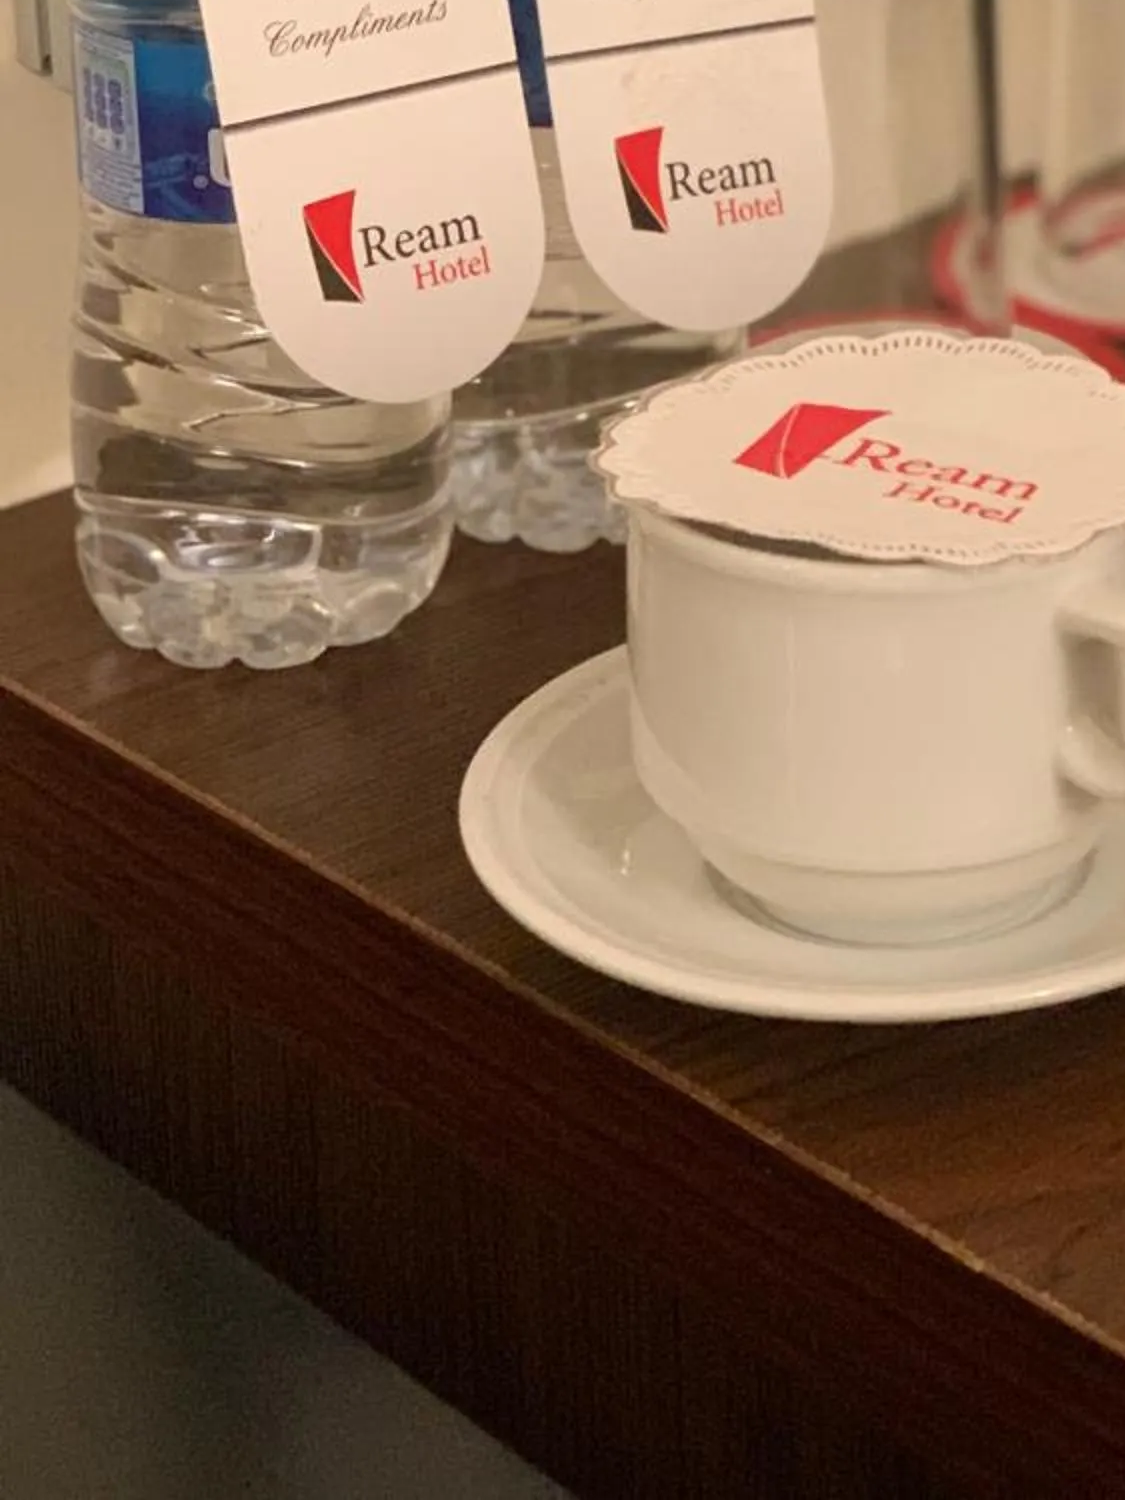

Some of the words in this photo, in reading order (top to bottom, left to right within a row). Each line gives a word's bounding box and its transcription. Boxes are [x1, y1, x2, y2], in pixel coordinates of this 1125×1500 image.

[664, 152, 777, 202] Ream
[714, 190, 785, 228] Hotel
[357, 213, 484, 269] Ream
[413, 247, 491, 292] Hotel
[832, 437, 1039, 501] Ream
[882, 481, 1023, 525] Hotel
